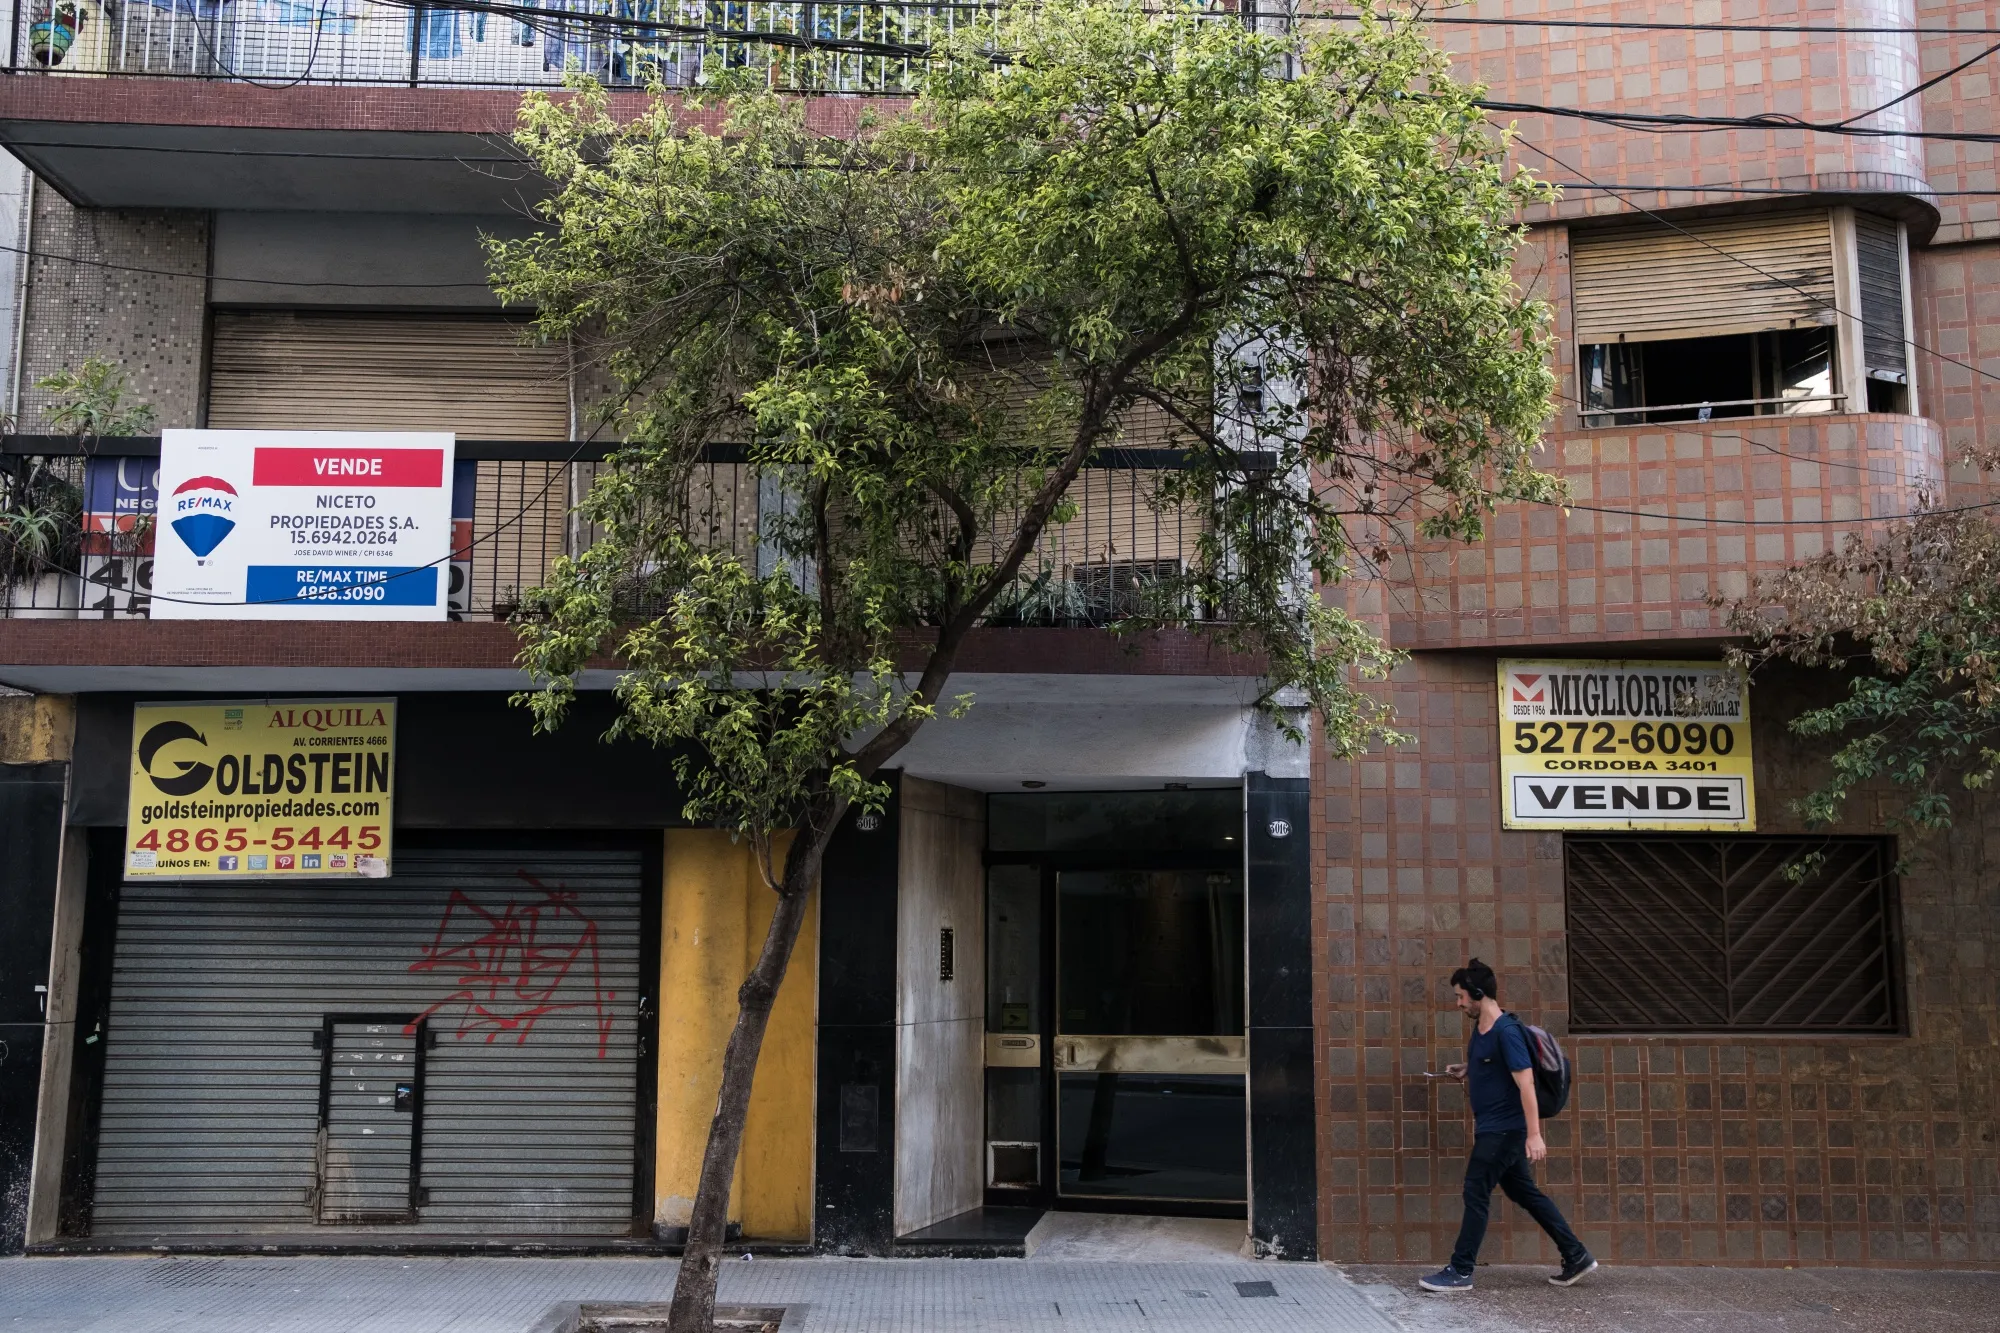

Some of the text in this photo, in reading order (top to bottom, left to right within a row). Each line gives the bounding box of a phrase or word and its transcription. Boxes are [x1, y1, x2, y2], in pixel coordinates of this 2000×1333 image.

[313, 457, 383, 476] VENDE
[177, 496, 233, 512] RE/MAX
[316, 495, 376, 509] NICETO
[270, 515, 420, 530] PROPIEDADES S.A.
[290, 530, 398, 545] 15.6942.0264
[312, 549, 334, 557] DAVID
[296, 569, 388, 584] RE/MAX TIME
[297, 586, 385, 601] 4858.3090
[1513, 704, 1546, 716] DESDE 1956
[267, 708, 388, 732] ALQUILA
[292, 736, 388, 747] AV. CORRIENTES 4666
[1514, 722, 1735, 756] 5272-6090
[138, 720, 389, 797] GOLDSTEIN
[1544, 759, 1718, 771] CORDOBA 3401
[1528, 784, 1731, 811] VENDE
[141, 798, 380, 824] goldsteinpropiedades.com
[857, 817, 877, 828] 3014
[135, 825, 382, 853] 4865-5445
[193, 859, 210, 868] EN:
